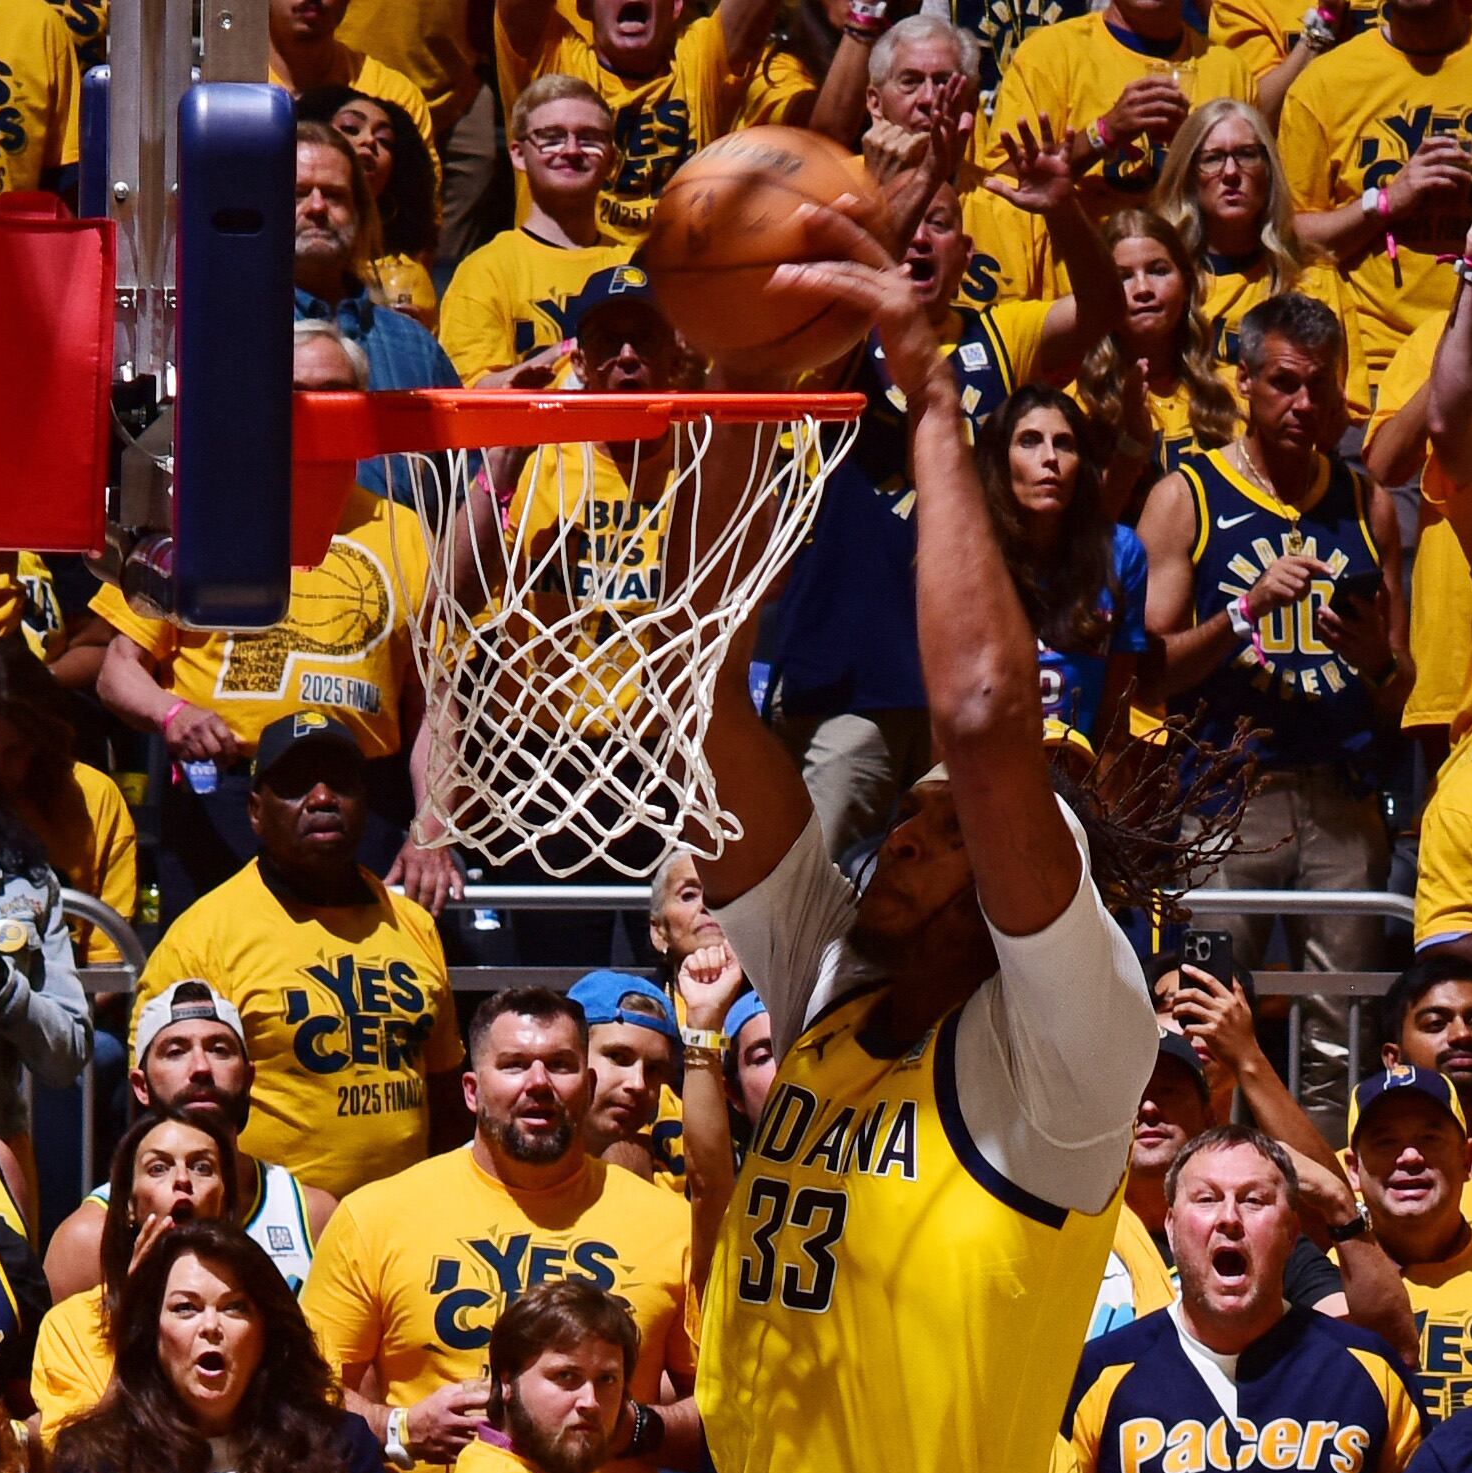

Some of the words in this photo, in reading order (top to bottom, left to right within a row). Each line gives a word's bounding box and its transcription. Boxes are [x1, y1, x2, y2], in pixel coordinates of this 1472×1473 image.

[301, 673, 344, 704] 2025
[305, 953, 425, 1014] YES
[337, 1084, 382, 1118] 2025
[467, 1233, 619, 1293] YES
[736, 1178, 850, 1314] 33
